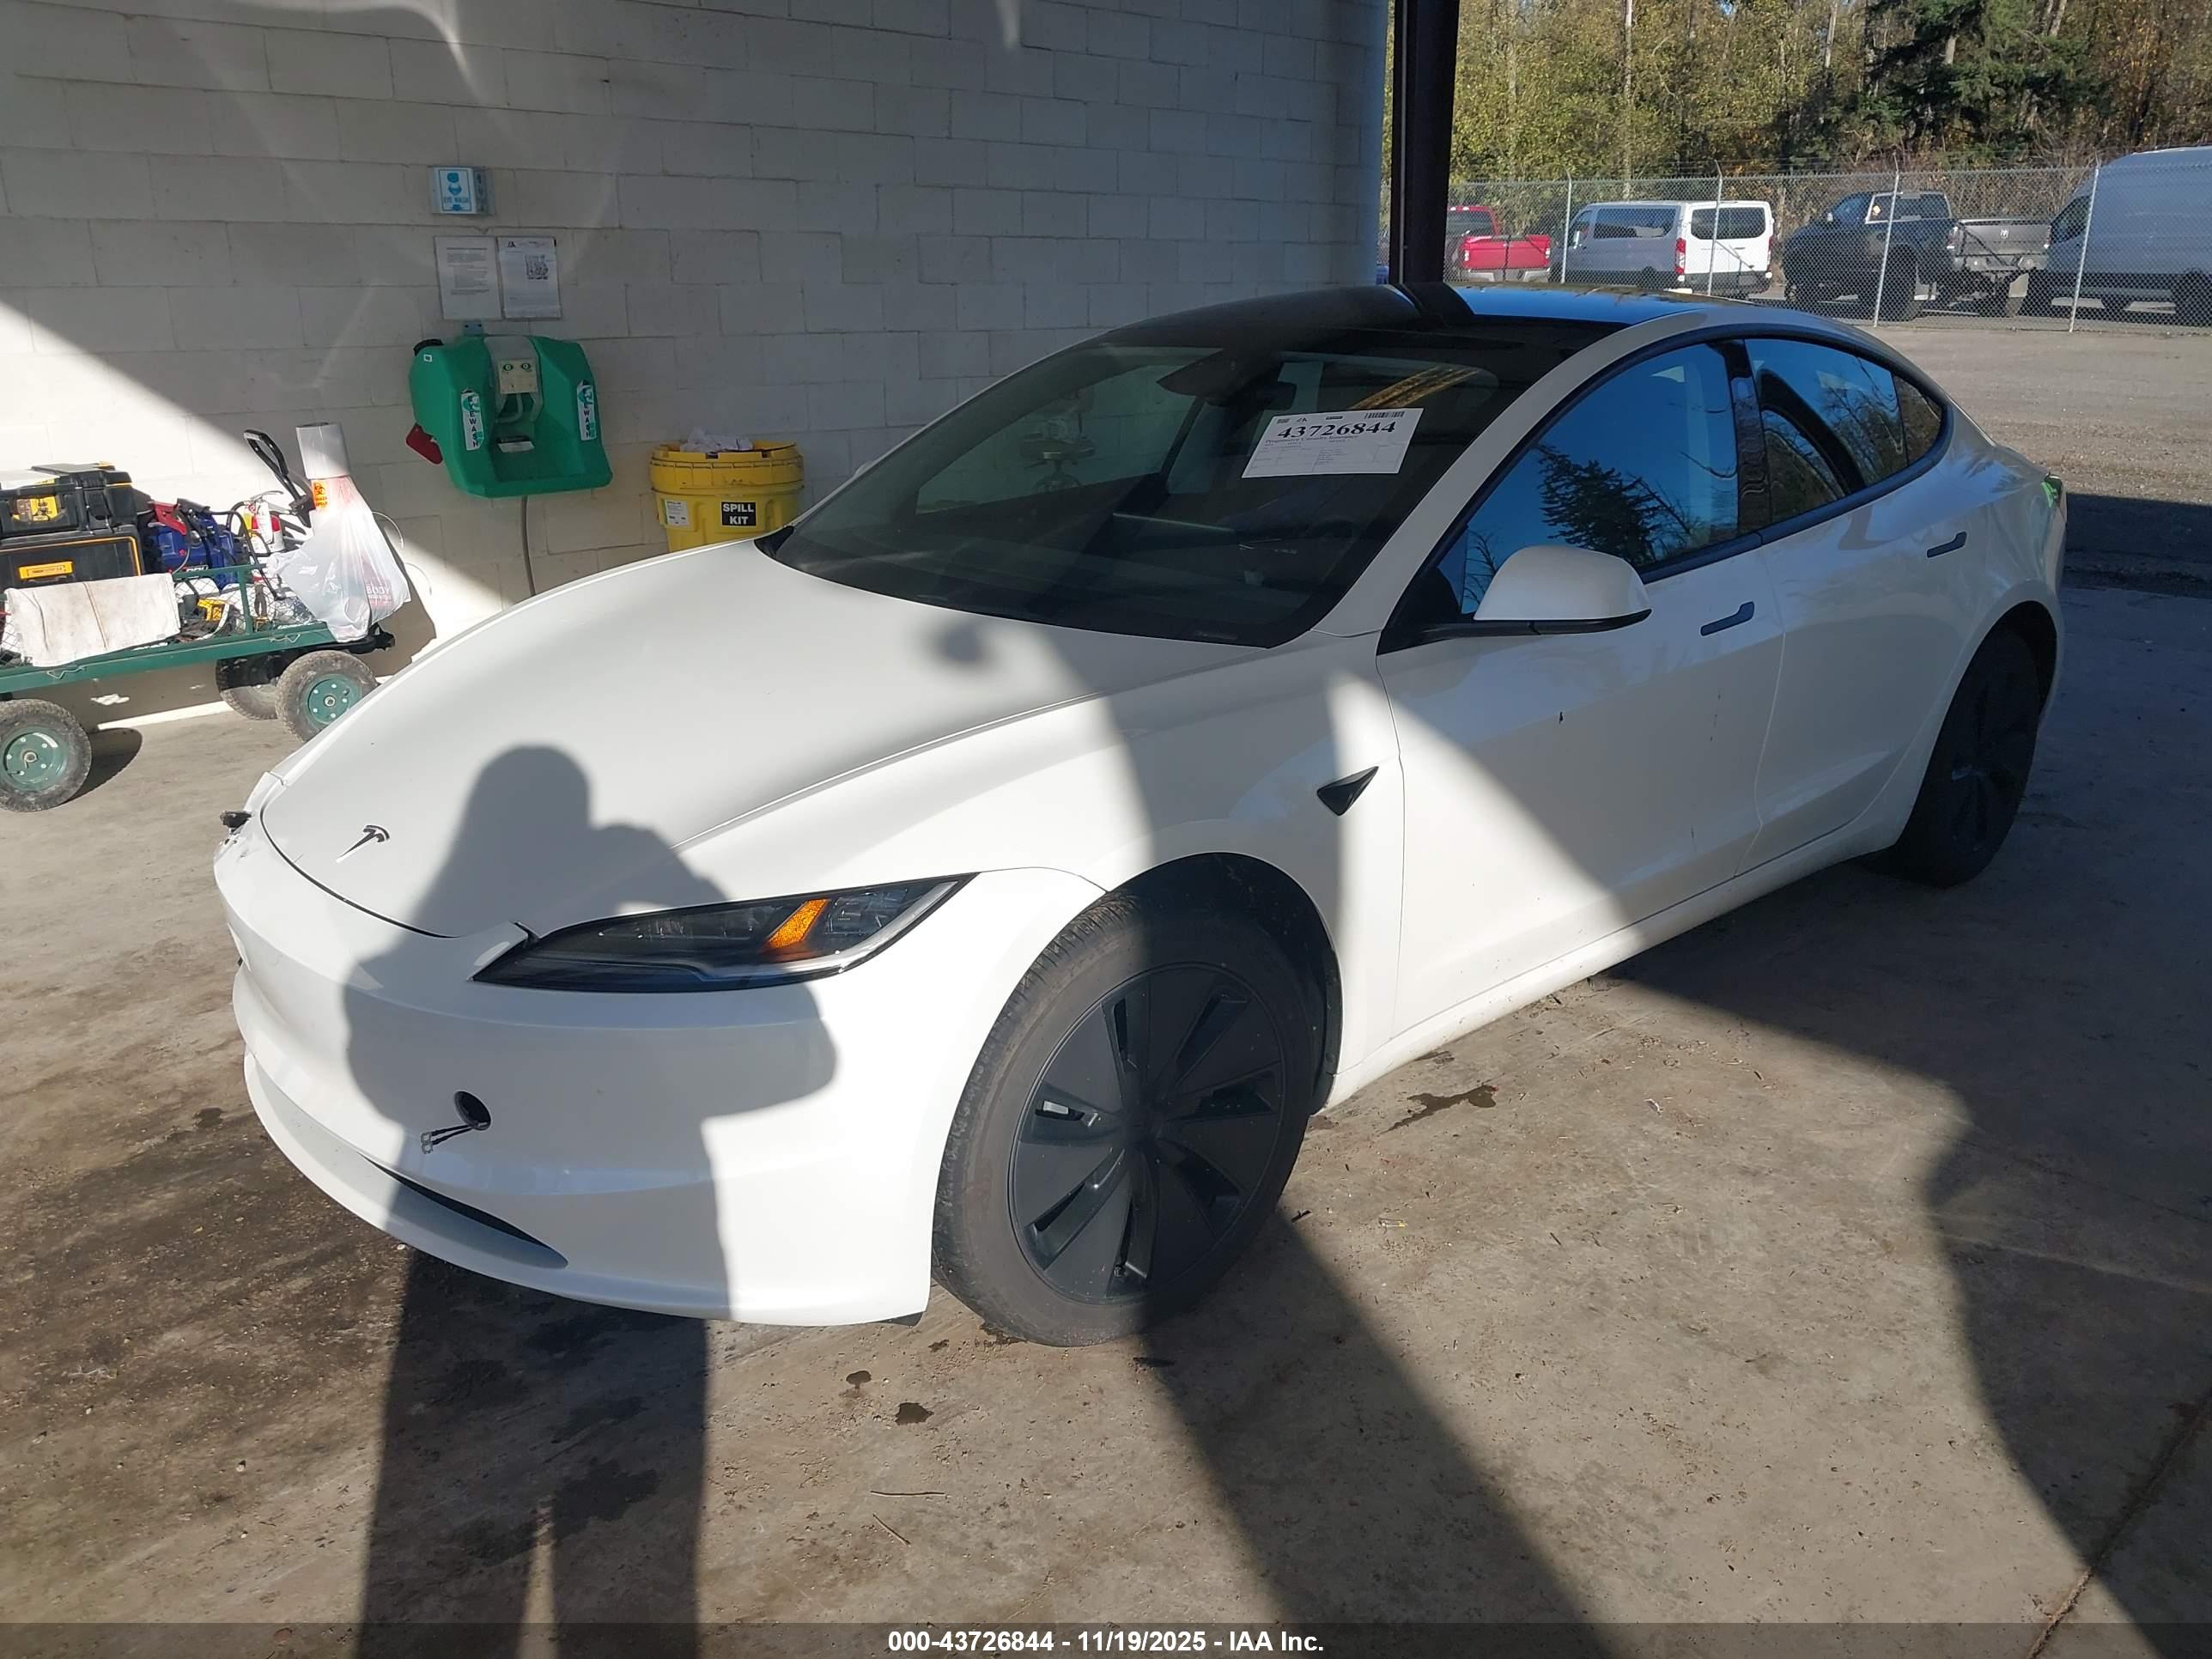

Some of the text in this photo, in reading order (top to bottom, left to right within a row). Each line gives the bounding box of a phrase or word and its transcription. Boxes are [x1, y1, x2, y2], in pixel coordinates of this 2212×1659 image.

[1277, 421, 1397, 439] 43726844
[722, 503, 755, 513] SPILL
[729, 515, 749, 525] KIT
